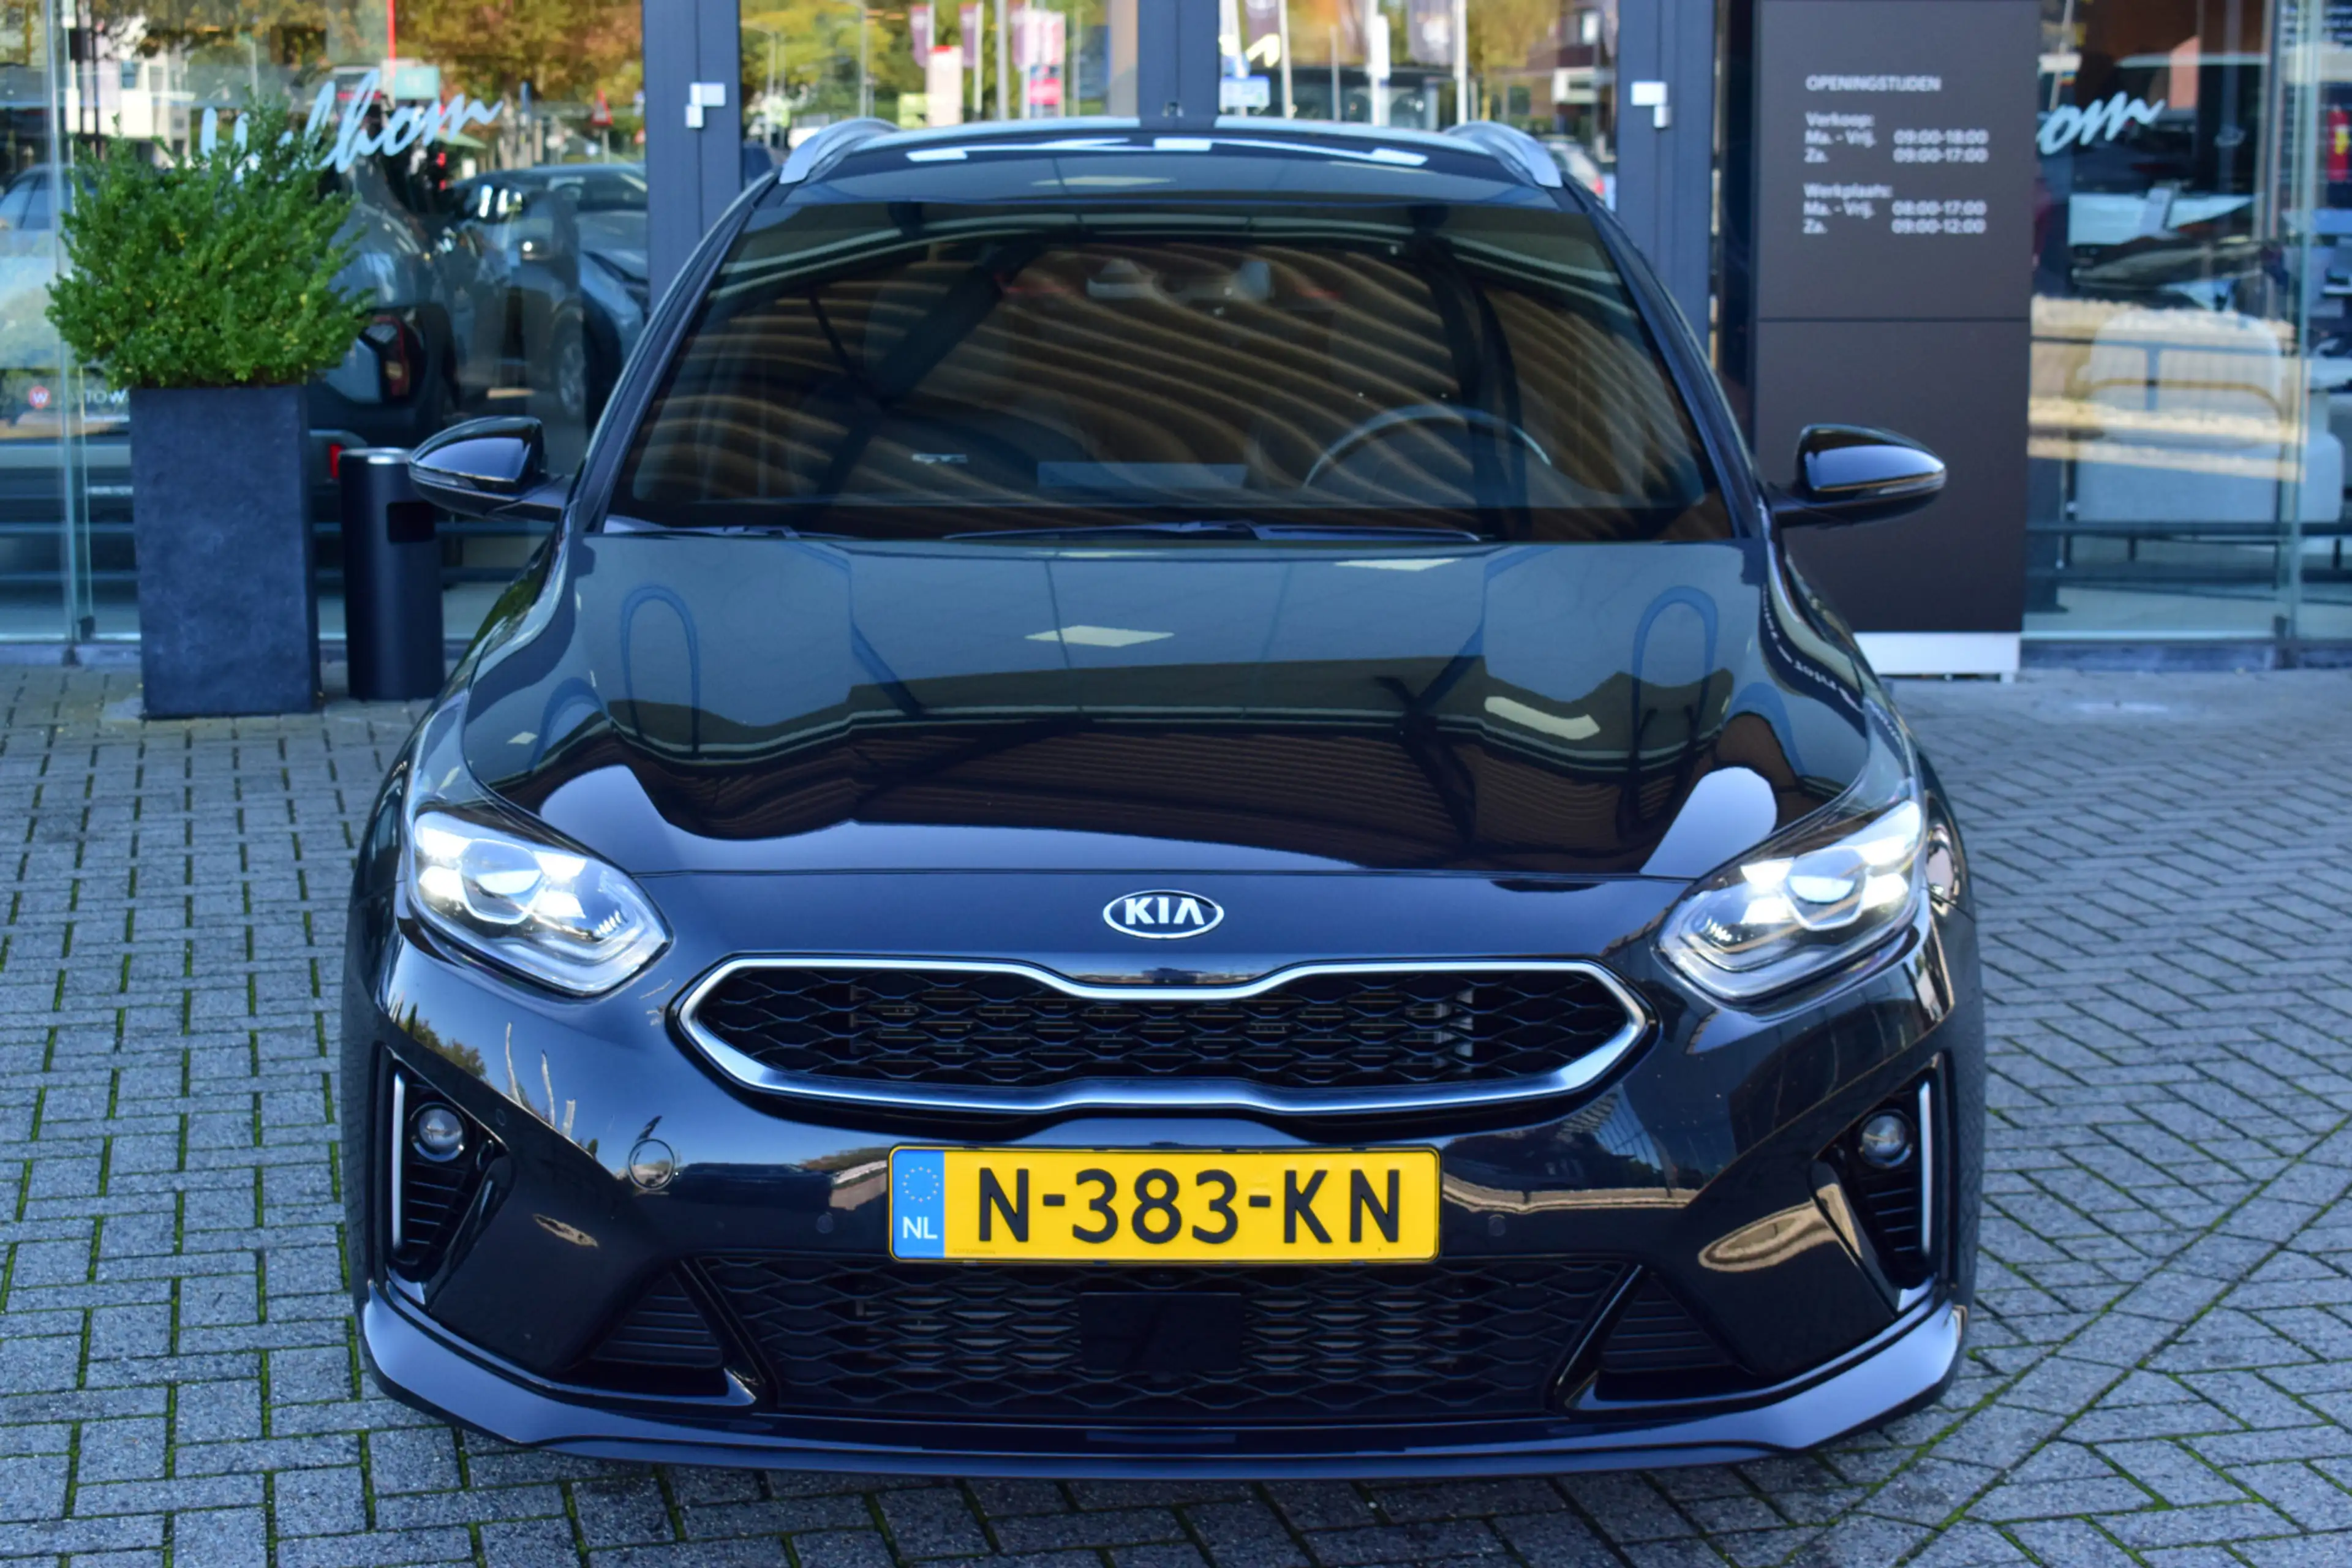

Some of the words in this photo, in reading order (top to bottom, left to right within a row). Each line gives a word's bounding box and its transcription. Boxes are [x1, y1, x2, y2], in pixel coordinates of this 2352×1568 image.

[1125, 897, 1205, 925] KIA
[903, 1216, 937, 1239] NL
[979, 1168, 1400, 1244] N-383-KN
